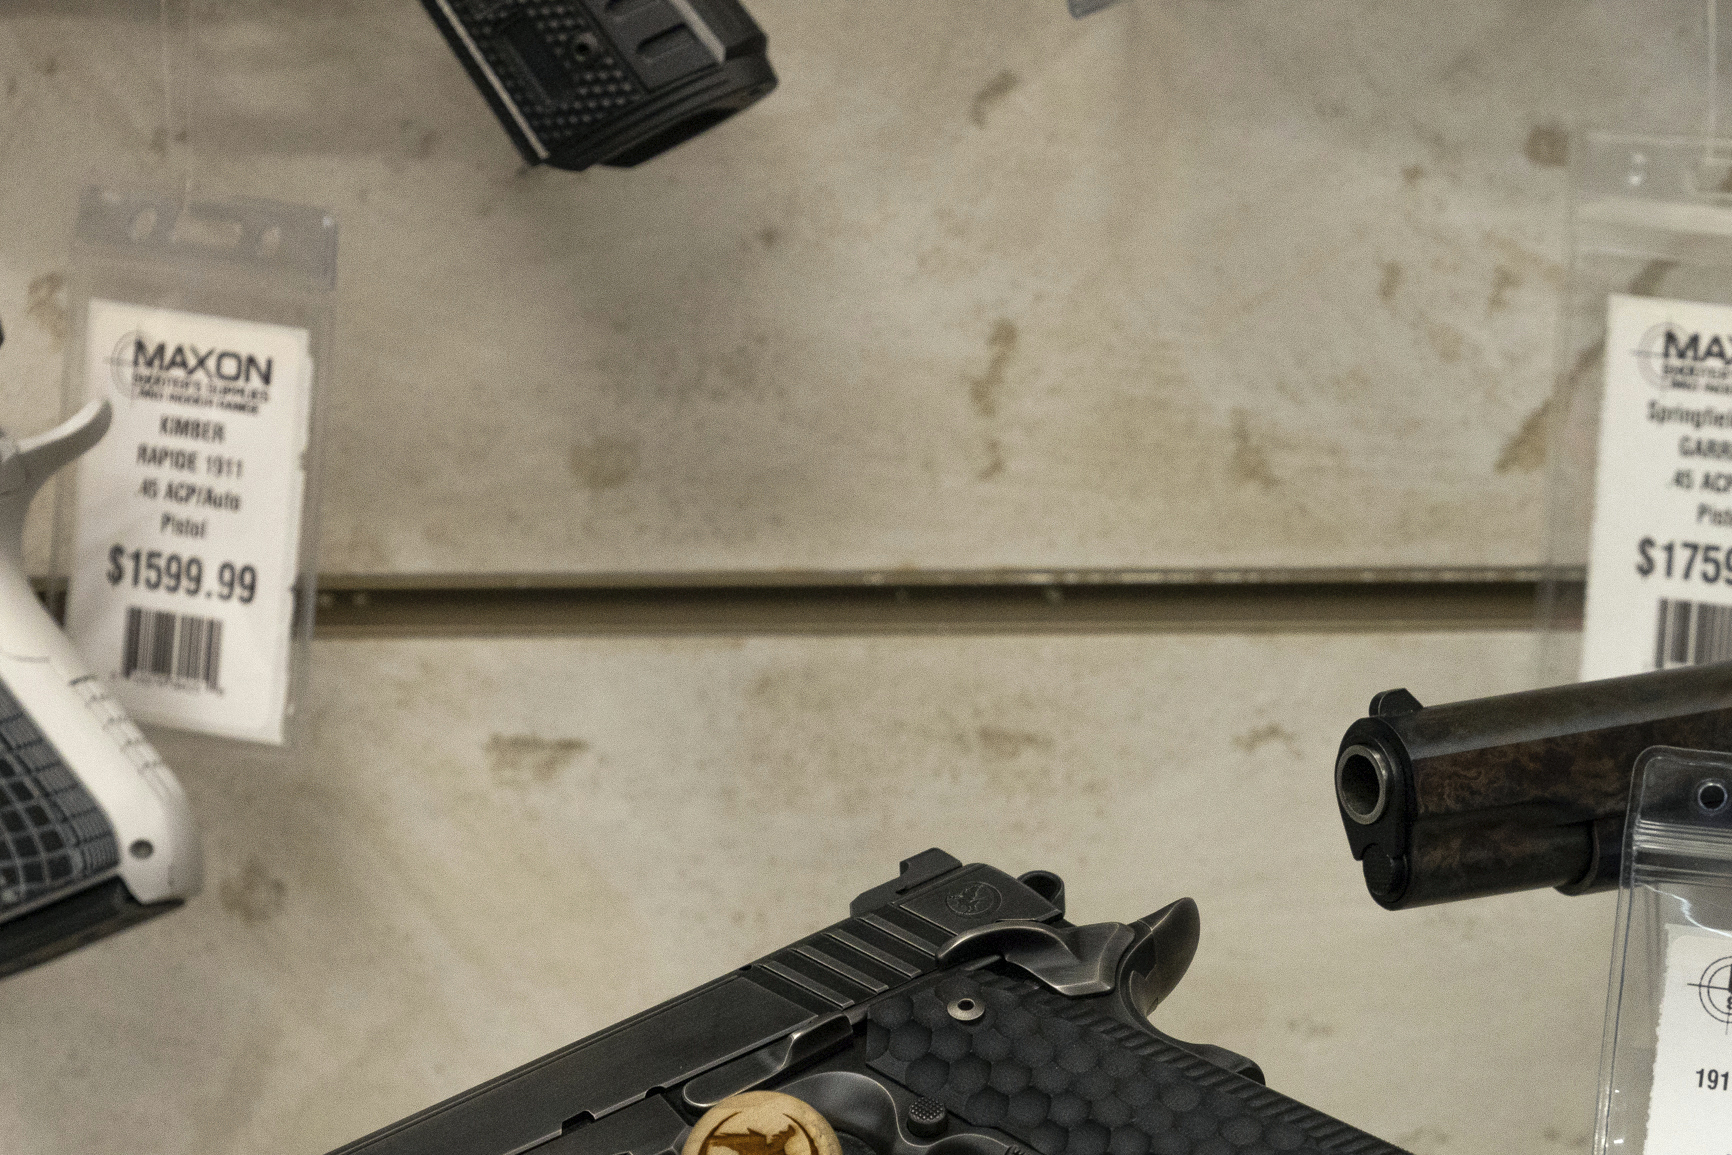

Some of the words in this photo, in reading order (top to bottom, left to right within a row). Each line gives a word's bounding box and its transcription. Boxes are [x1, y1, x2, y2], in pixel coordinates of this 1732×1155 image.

[133, 337, 273, 386] MAXON
[160, 415, 226, 444] KIMBER
[205, 453, 244, 480] 1911
[164, 479, 241, 514] ACP/Auto
[160, 512, 207, 539] Pistol
[106, 542, 257, 605] $1599.99
